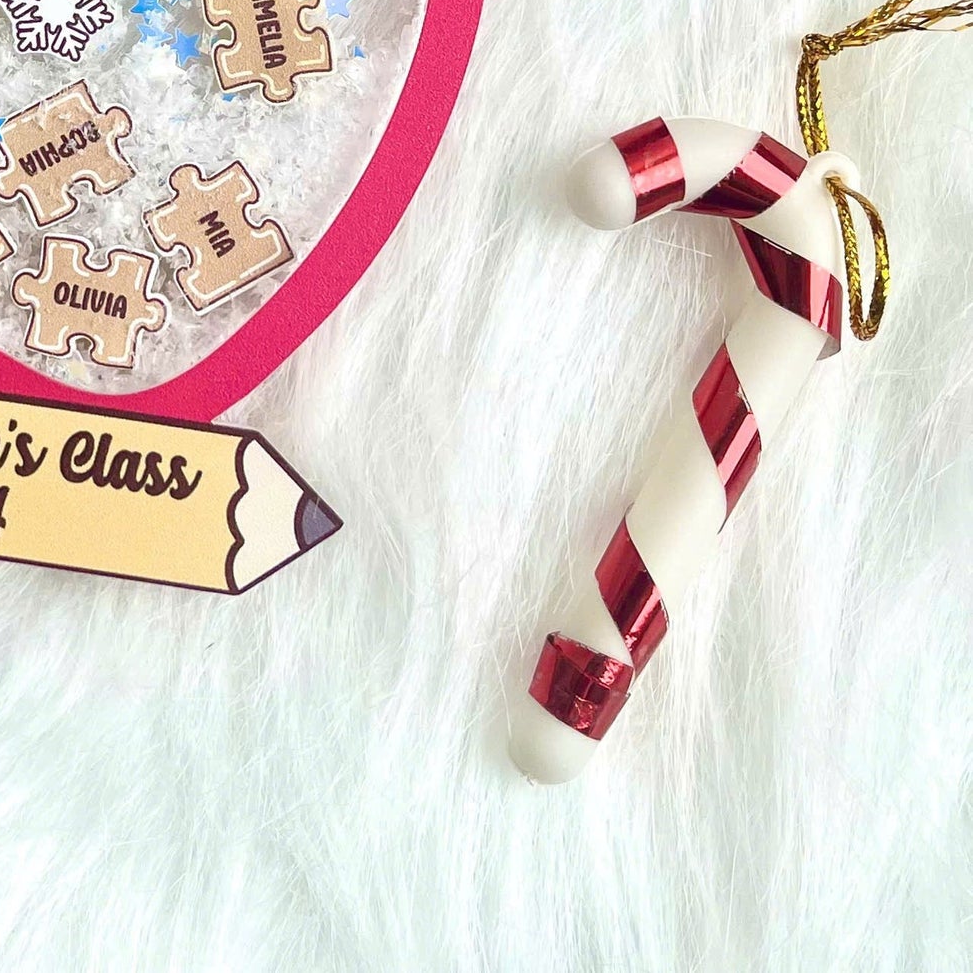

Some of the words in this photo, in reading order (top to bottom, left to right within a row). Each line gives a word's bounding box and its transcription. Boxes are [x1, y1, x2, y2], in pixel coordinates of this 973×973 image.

[19, 121, 100, 176] SOPHIA
[200, 211, 235, 258] MIA
[54, 282, 127, 319] OLIVIA
[60, 431, 202, 500] Class
